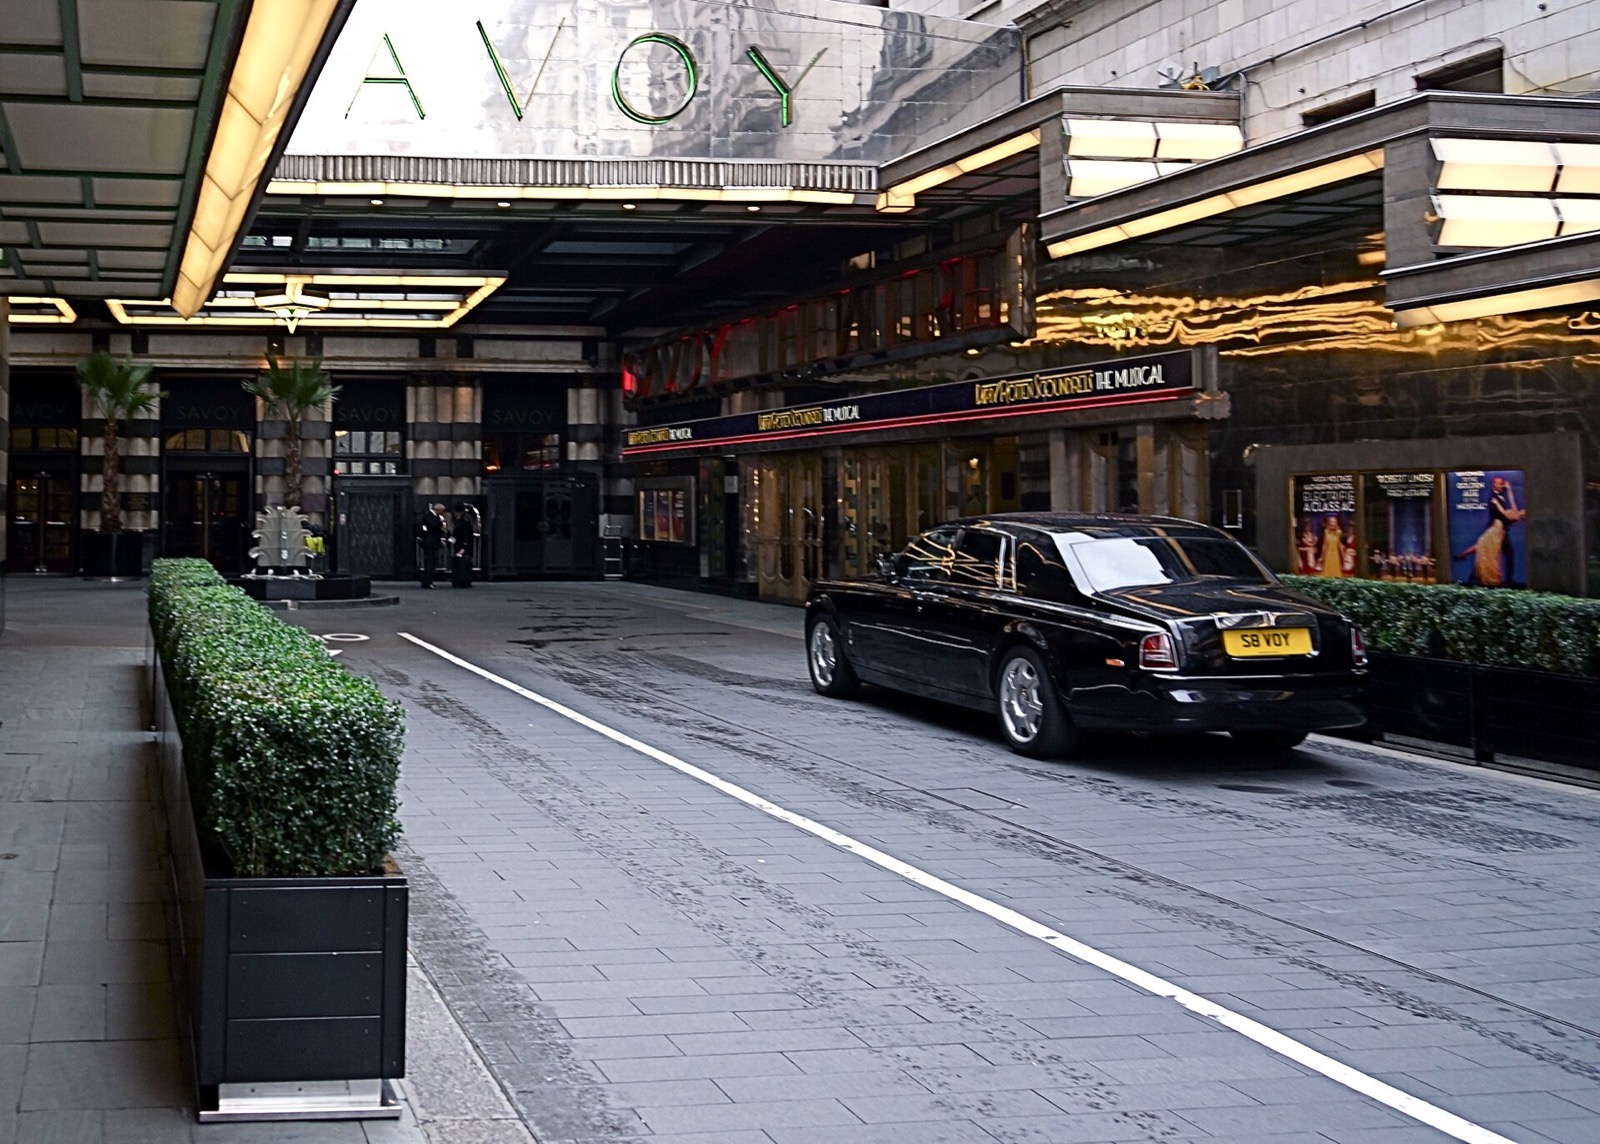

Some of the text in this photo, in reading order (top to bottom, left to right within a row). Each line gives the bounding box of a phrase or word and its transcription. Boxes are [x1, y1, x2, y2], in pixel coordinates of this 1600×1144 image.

[1094, 370, 1114, 390] THE
[1114, 364, 1166, 388] MUSICAL
[176, 405, 240, 421] SAVOY
[337, 406, 401, 422] SAVOY
[493, 407, 554, 425] SAVOY
[1262, 632, 1290, 647] VOY
